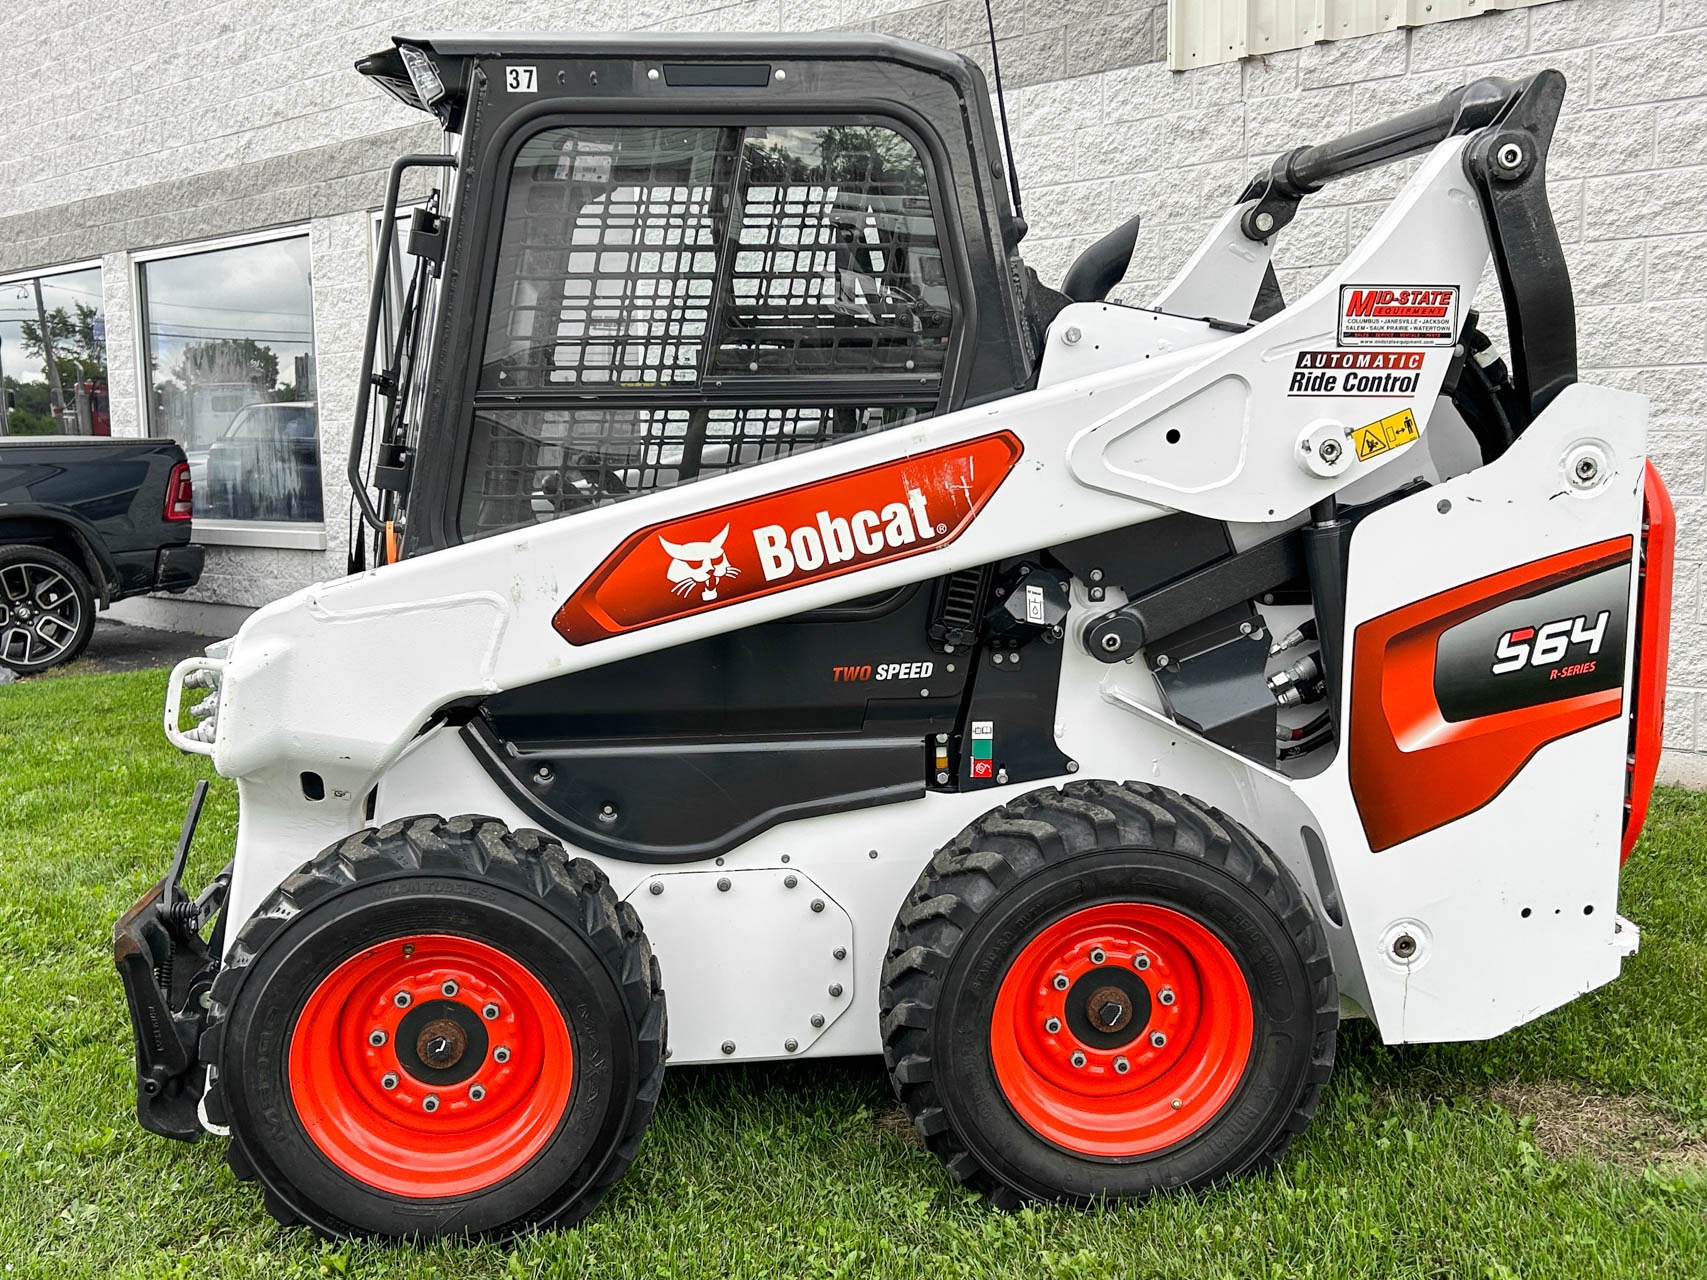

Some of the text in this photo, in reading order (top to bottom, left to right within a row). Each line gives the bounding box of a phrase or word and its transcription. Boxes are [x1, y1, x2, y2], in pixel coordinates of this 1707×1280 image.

[509, 68, 534, 90] 37
[1346, 290, 1454, 317] MID-STATE
[1377, 307, 1442, 316] EQUIPMENT
[1300, 353, 1421, 368] AUTOMATIC
[1289, 371, 1421, 393] Ride Control
[752, 487, 936, 582] Bobcat
[1491, 611, 1611, 675] S64
[832, 661, 934, 682] TWO SPEED
[1550, 660, 1597, 680] R-SERIES
